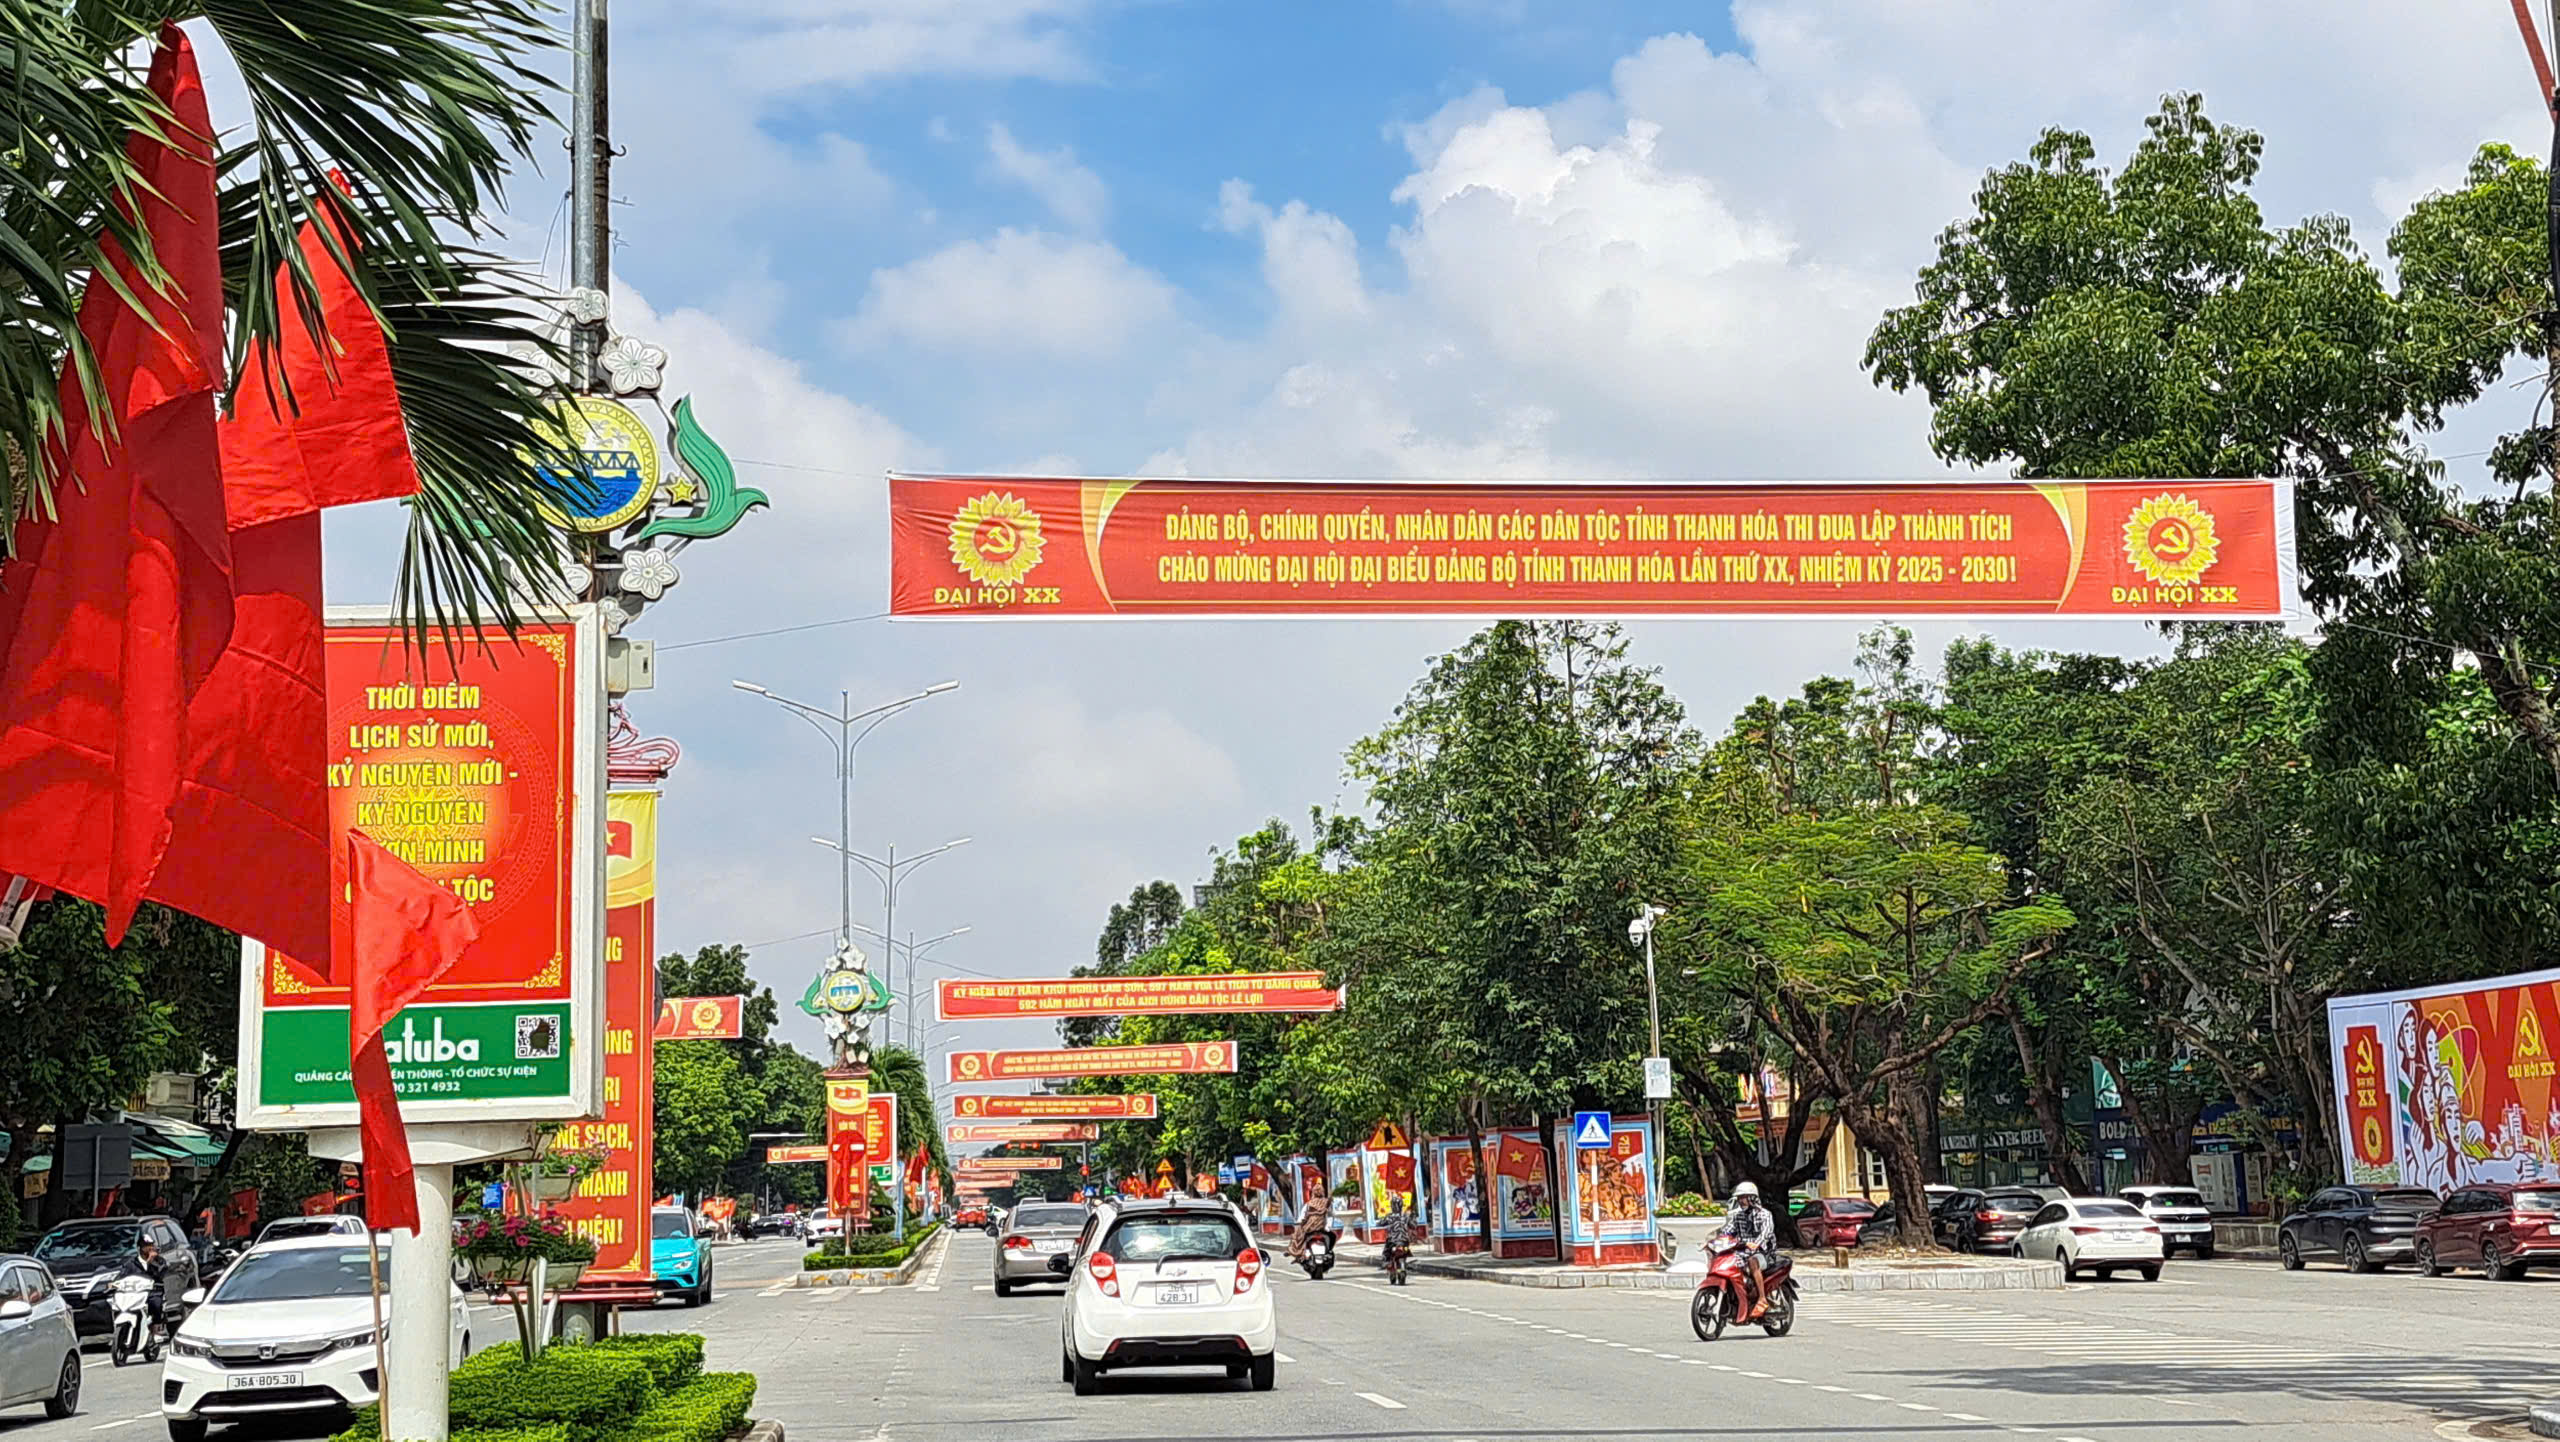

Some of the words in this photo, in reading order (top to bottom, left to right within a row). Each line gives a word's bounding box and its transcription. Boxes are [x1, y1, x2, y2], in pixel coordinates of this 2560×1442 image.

[1166, 505, 1218, 541] ĐẢNG
[1224, 509, 1254, 546] BỘ,
[1260, 509, 1318, 541] CHÍNH
[1323, 505, 1391, 544] QUYỀN,
[1396, 509, 1448, 541] NHÂN
[1454, 509, 1492, 541] DÂN
[1498, 509, 1535, 541] CÁC
[1541, 509, 1579, 541] DÂN
[1584, 509, 1620, 546] TỘC
[1625, 506, 1668, 541] TỈNH
[1673, 514, 1735, 541] THANH
[1741, 509, 1779, 541] HÓA
[1784, 514, 1813, 541] THI
[1818, 514, 1856, 541] ĐUA
[1861, 509, 1896, 546] LẬP
[1901, 509, 1964, 541] THÀNH
[1969, 509, 2012, 541] TÍCH
[1159, 550, 1209, 582] CHÀO
[1215, 550, 1271, 582] MỪNG
[1276, 556, 1308, 588] ĐẠI
[1314, 550, 1345, 588] HỘI
[1350, 556, 1382, 588] ĐẠI
[1387, 545, 1430, 582] BIỂU
[1435, 548, 1486, 582] ĐẢNG
[1492, 550, 1517, 588] BỘ
[1522, 548, 1565, 582] TỈNH
[1570, 556, 1632, 582] THANH
[1637, 550, 1675, 582] HÓA
[1681, 546, 1717, 582] LẦN
[1722, 550, 1760, 582] THỨ
[1763, 556, 1794, 585] XX,
[1800, 550, 1862, 588] NHIỆM
[1867, 550, 1891, 582] KỲ
[1897, 556, 1943, 582] 2025
[1962, 556, 2016, 582] 2030!
[934, 587, 971, 608] ĐẠI
[978, 584, 1016, 608] HỘI
[1023, 587, 1060, 603] XX
[2112, 587, 2148, 607] ĐẠI
[2155, 583, 2193, 608] HỘI
[2199, 586, 2239, 603] XX
[366, 681, 416, 710] THỜI
[350, 725, 400, 753] LỊCH
[407, 718, 440, 747] SỬ
[444, 720, 494, 749] MỚI,
[328, 757, 354, 787] KỶ
[361, 759, 452, 786] NGUYÊN
[459, 758, 503, 785] MỚI
[358, 795, 386, 825] KỶ
[394, 797, 485, 825] NGUYÊN
[424, 836, 485, 863] MÌNH
[452, 874, 494, 906] TỘC
[384, 1016, 479, 1063] atuba
[295, 1069, 332, 1083] QUẢNG
[407, 1082, 428, 1093] 321
[431, 1080, 460, 1092] 4932
[604, 1076, 621, 1107] RỊ
